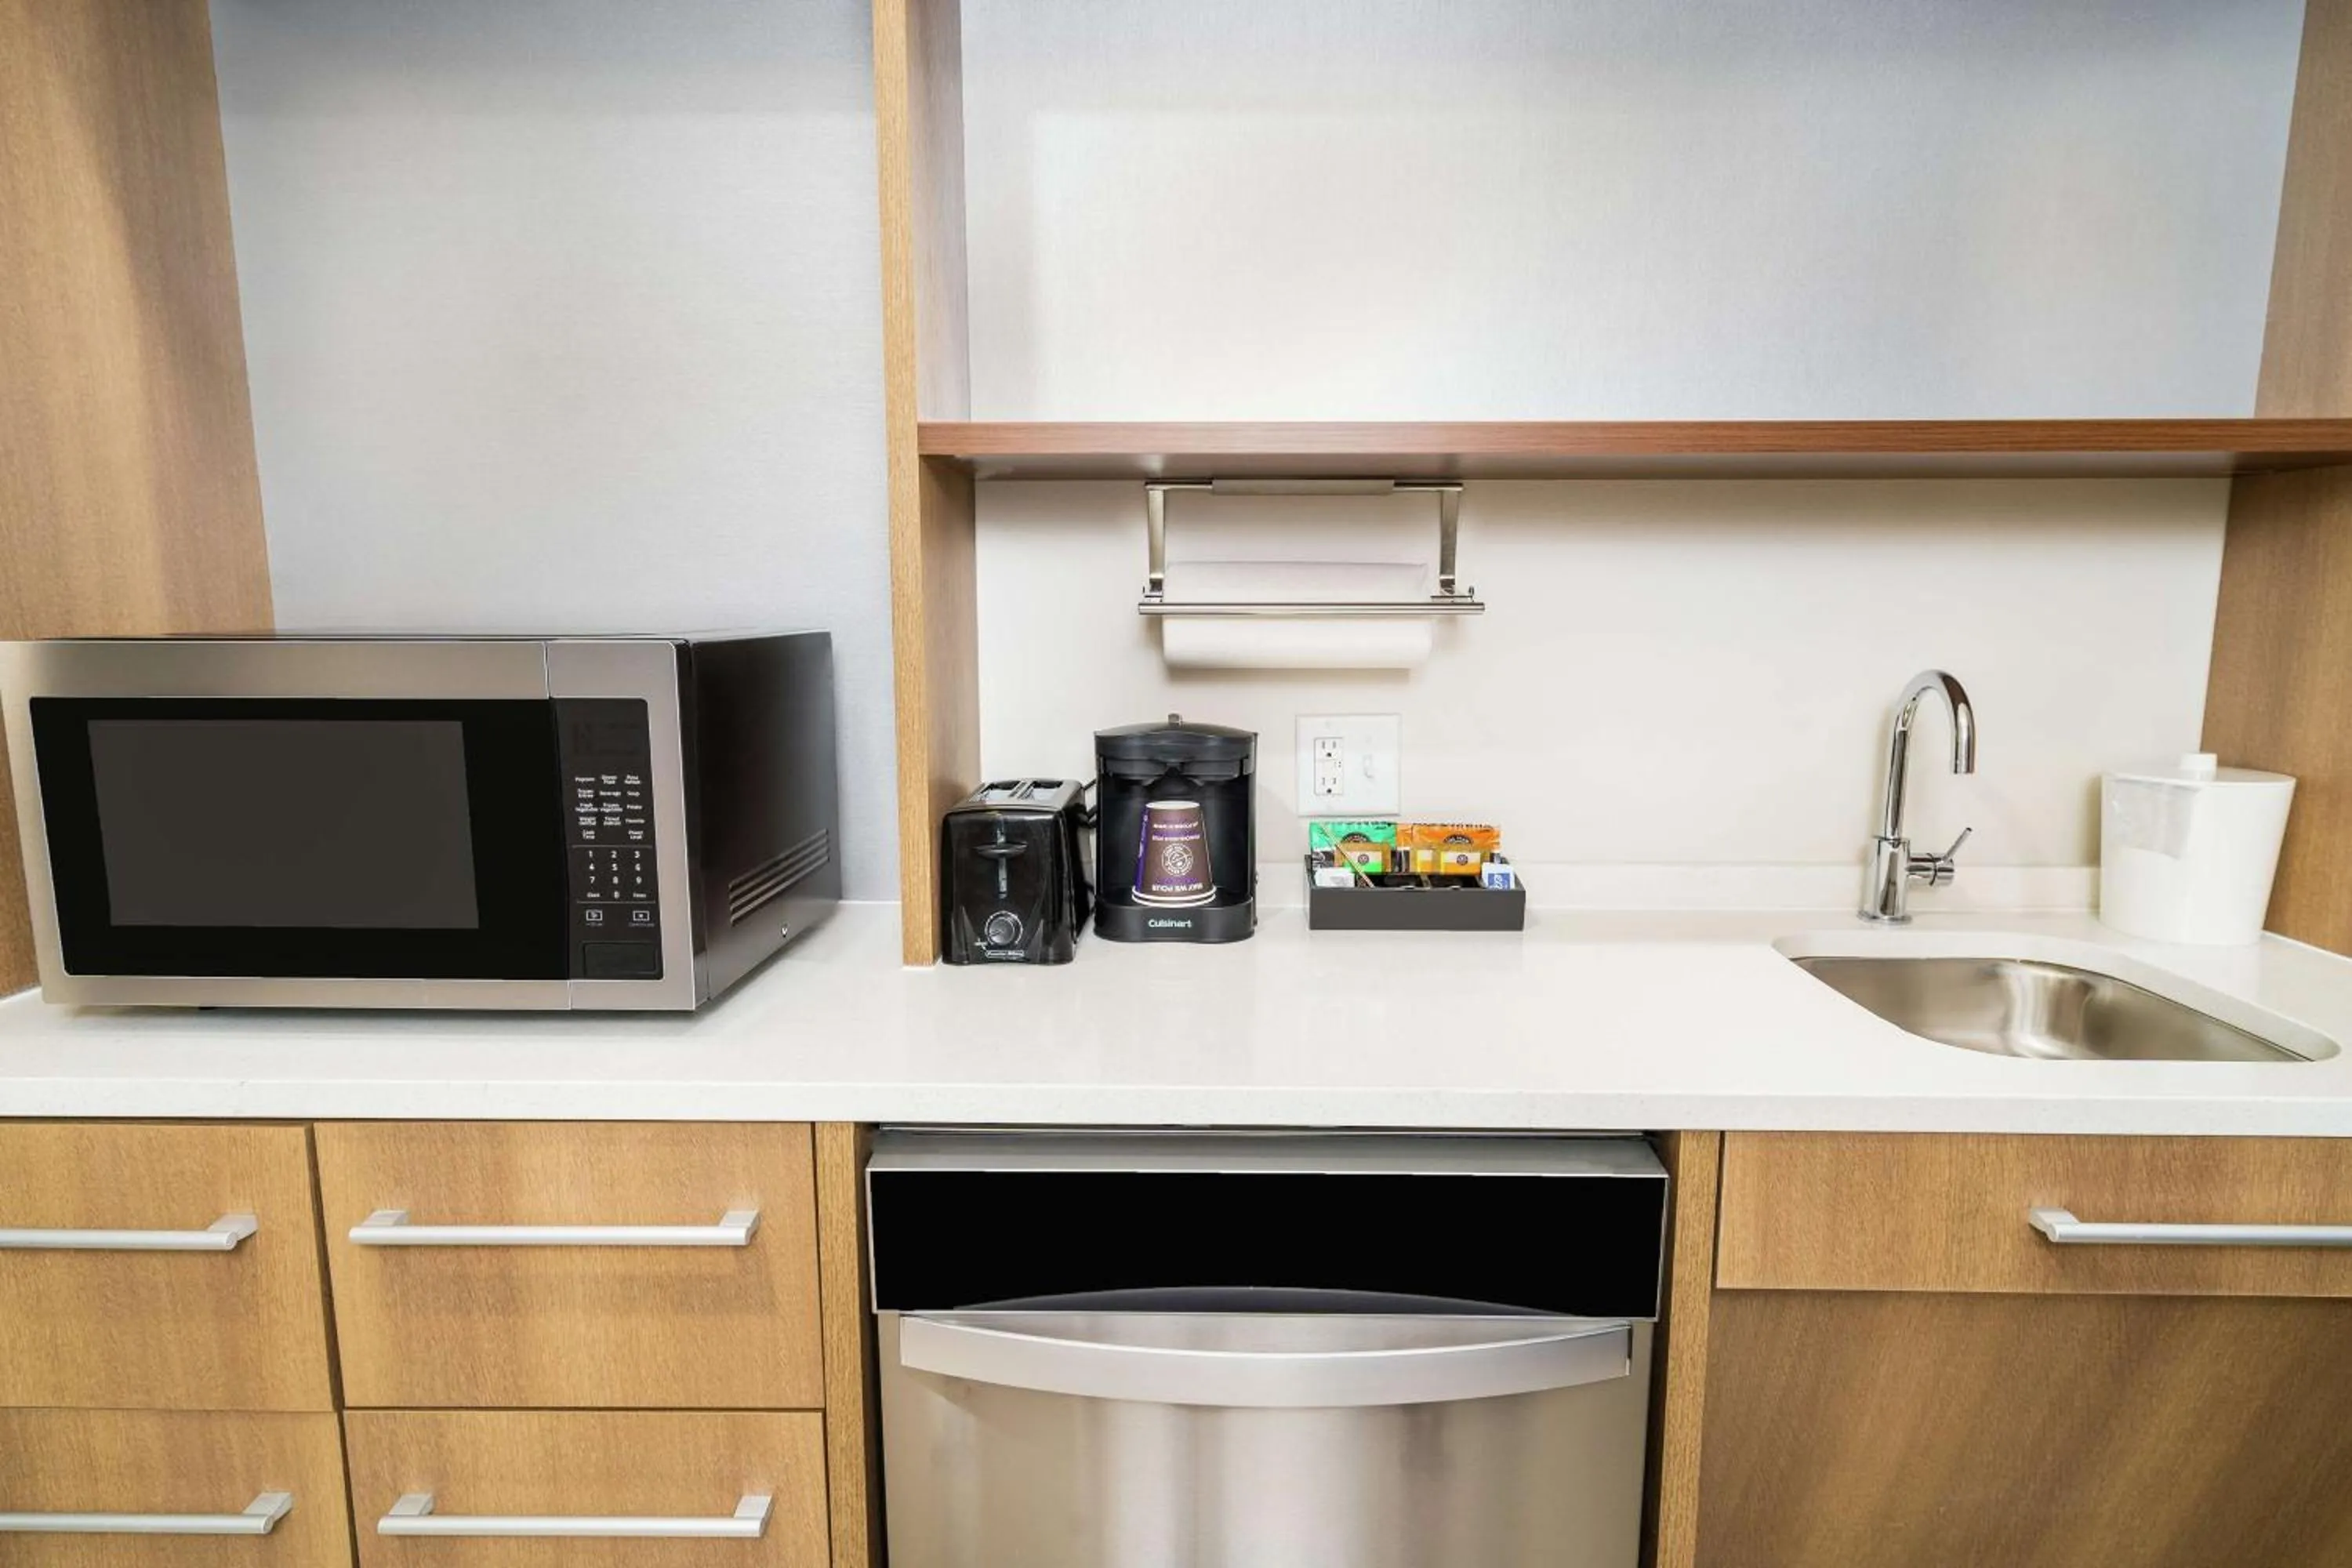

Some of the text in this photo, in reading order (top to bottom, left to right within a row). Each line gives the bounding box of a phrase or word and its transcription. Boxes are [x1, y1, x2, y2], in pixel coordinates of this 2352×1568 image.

[611, 850, 617, 858] 2
[612, 876, 619, 884] 8
[636, 876, 642, 884] 9
[1148, 918, 1192, 928] Cuisinart
